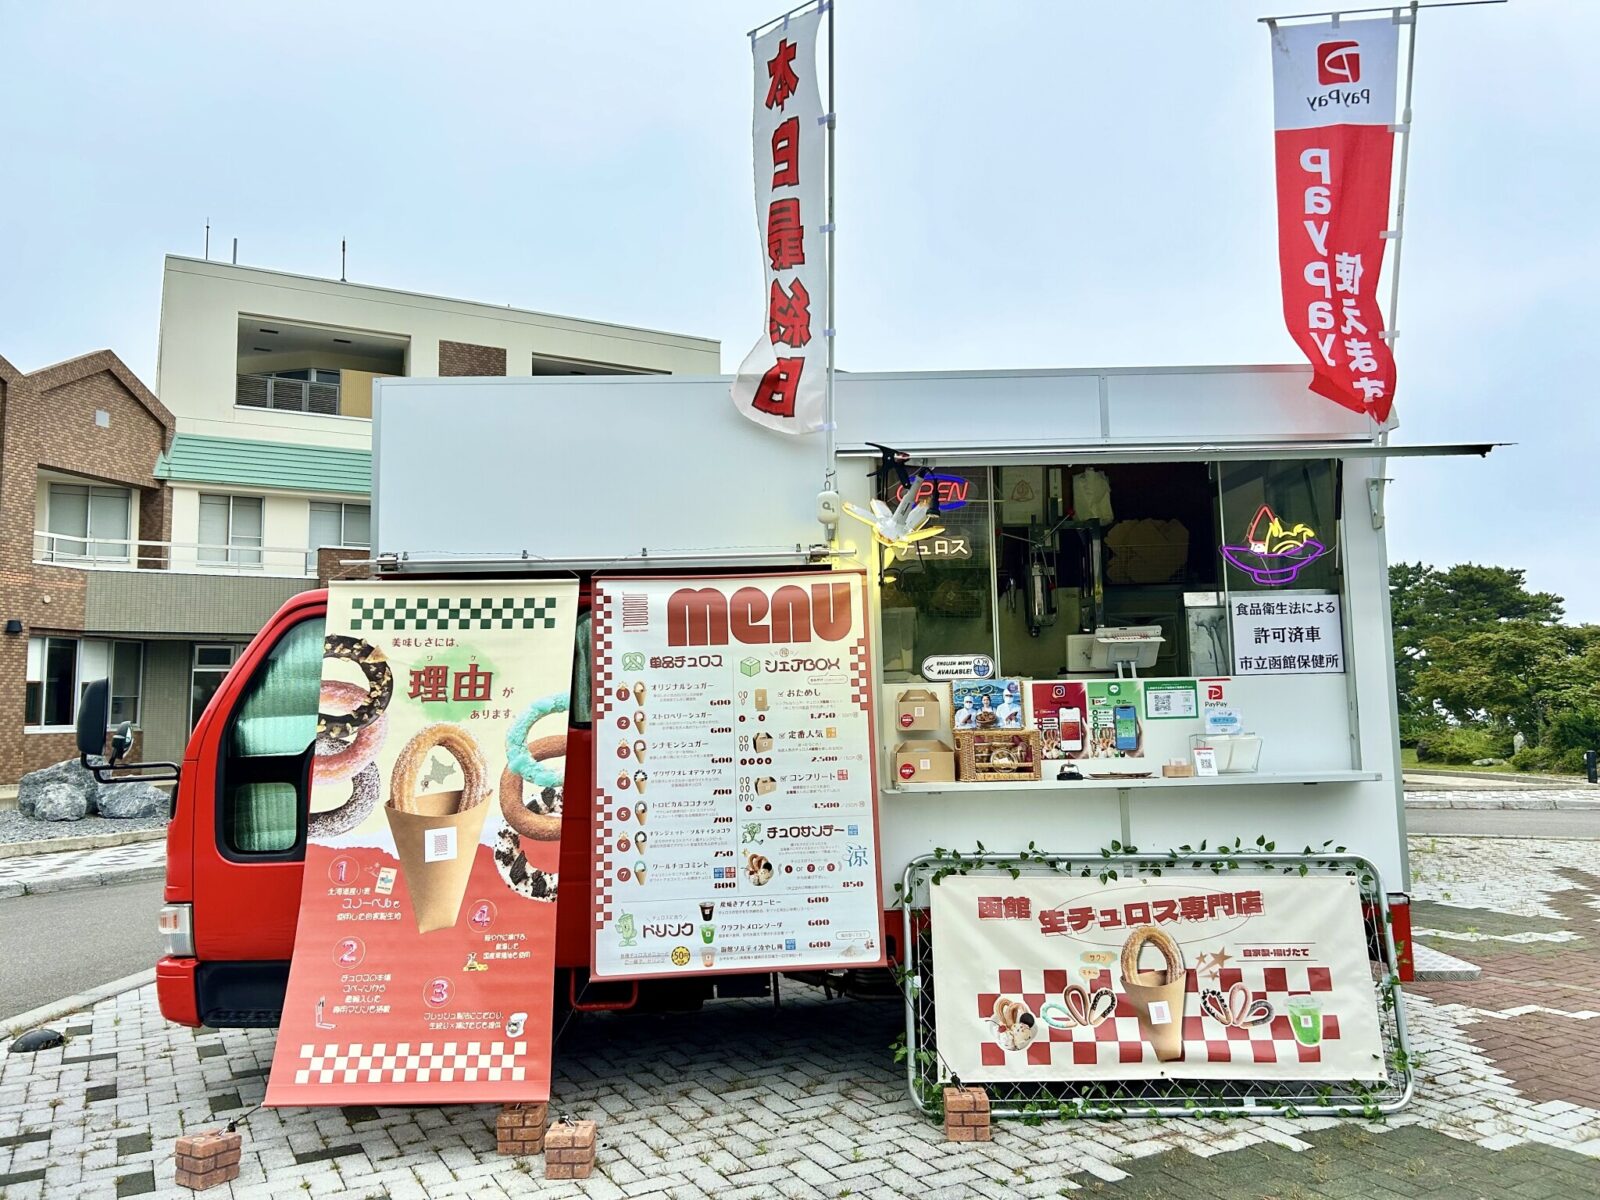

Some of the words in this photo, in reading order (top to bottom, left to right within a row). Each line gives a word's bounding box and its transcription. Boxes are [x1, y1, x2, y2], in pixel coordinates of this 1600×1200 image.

[1236, 602, 1335, 617] 食品衛生法による
[1254, 626, 1321, 643] 許可済車
[392, 637, 460, 648] 美味しさには、
[650, 655, 723, 668] 単品チュロス
[1239, 654, 1339, 671] 市立函館保健所
[408, 663, 494, 703] 理由
[502, 686, 514, 698] が
[651, 682, 715, 691] オリジナルシュガー
[787, 689, 820, 697] おためし
[788, 729, 823, 739] 定番人気
[652, 740, 709, 749] シナモンシュガー
[789, 772, 835, 781] コンプリート
[652, 800, 715, 809] トロピカルココナッツ
[767, 825, 845, 839] チュロサンデー
[847, 845, 868, 867] 涼
[978, 896, 1031, 919] 函館
[1038, 890, 1263, 936] 生チュロス専門店
[643, 922, 694, 938] ドリンク
[721, 922, 783, 931] クラフトメロンソーダ
[1243, 948, 1309, 957] 自家製・揚げたて
